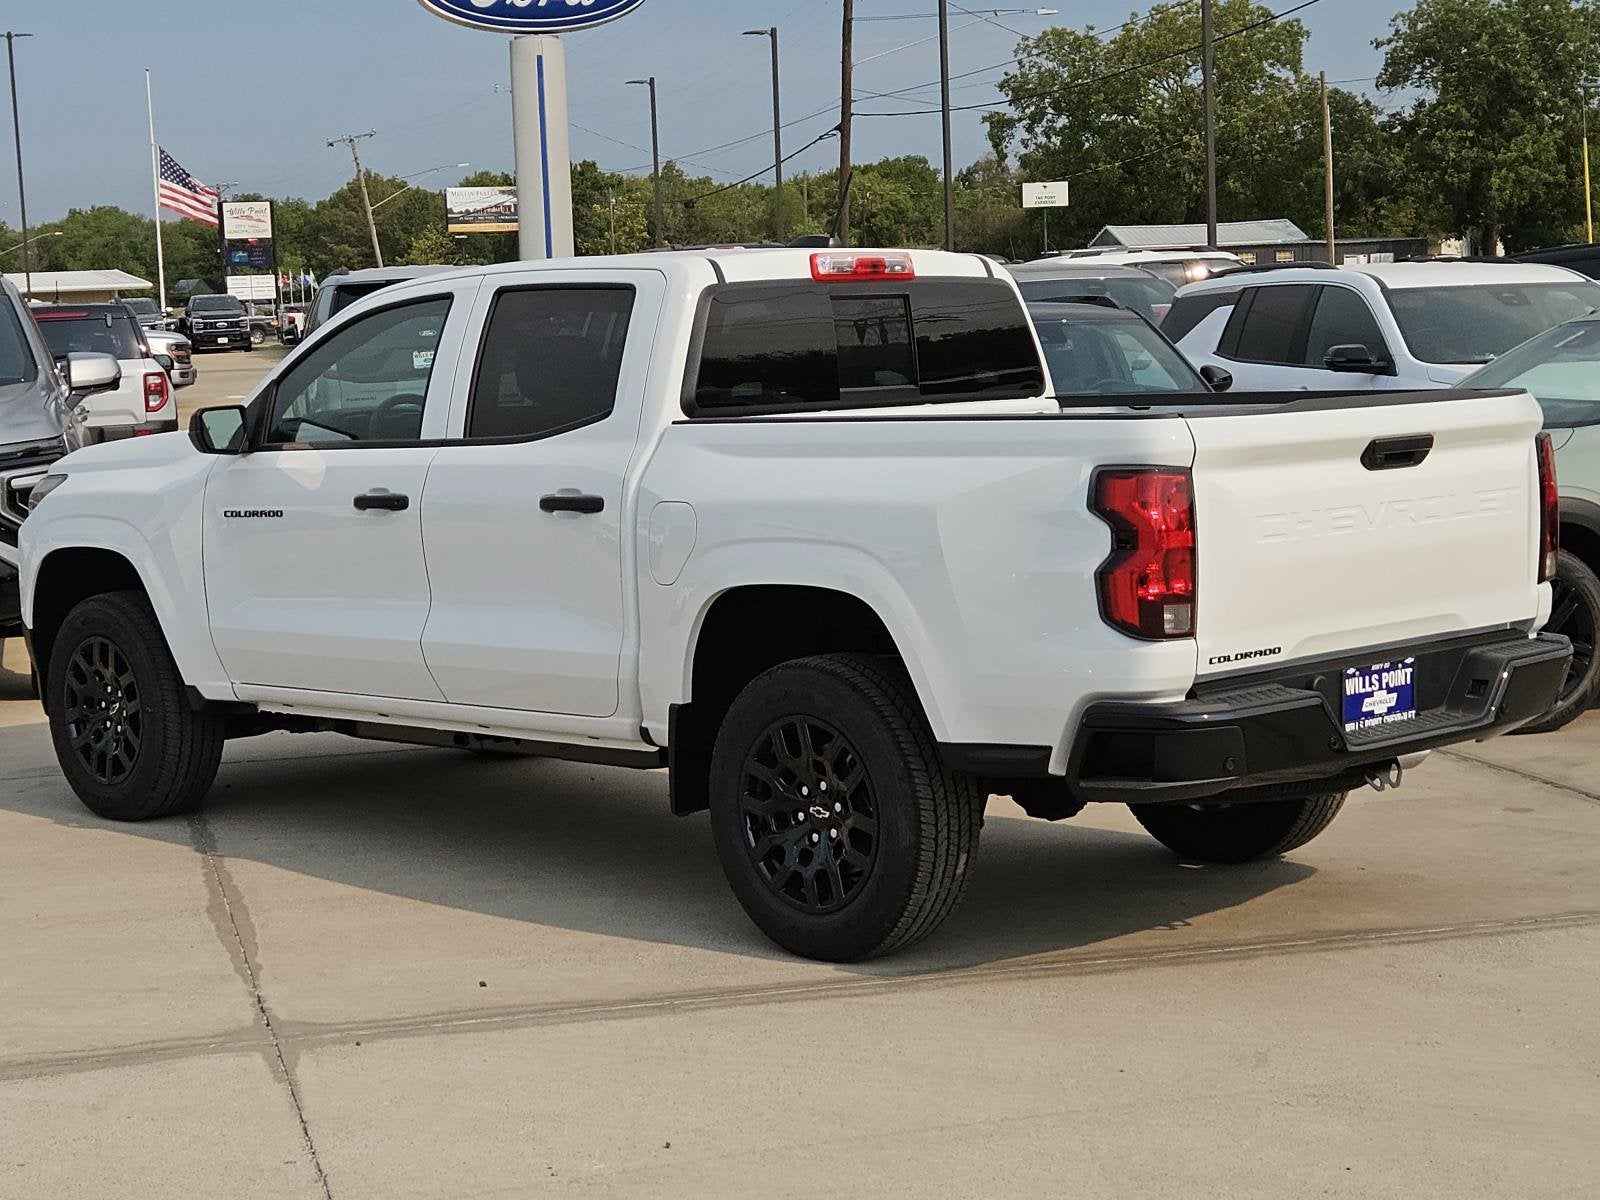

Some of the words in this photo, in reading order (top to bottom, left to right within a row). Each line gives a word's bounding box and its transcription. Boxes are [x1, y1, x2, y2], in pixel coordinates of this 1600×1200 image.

[224, 510, 284, 518] COLORADO
[1254, 485, 1521, 544] CHEVROLET
[1208, 646, 1282, 665] COLORADO
[1345, 673, 1380, 696] WILLS
[1381, 667, 1413, 689] POINT
[1364, 696, 1395, 708] CHEVROLET
